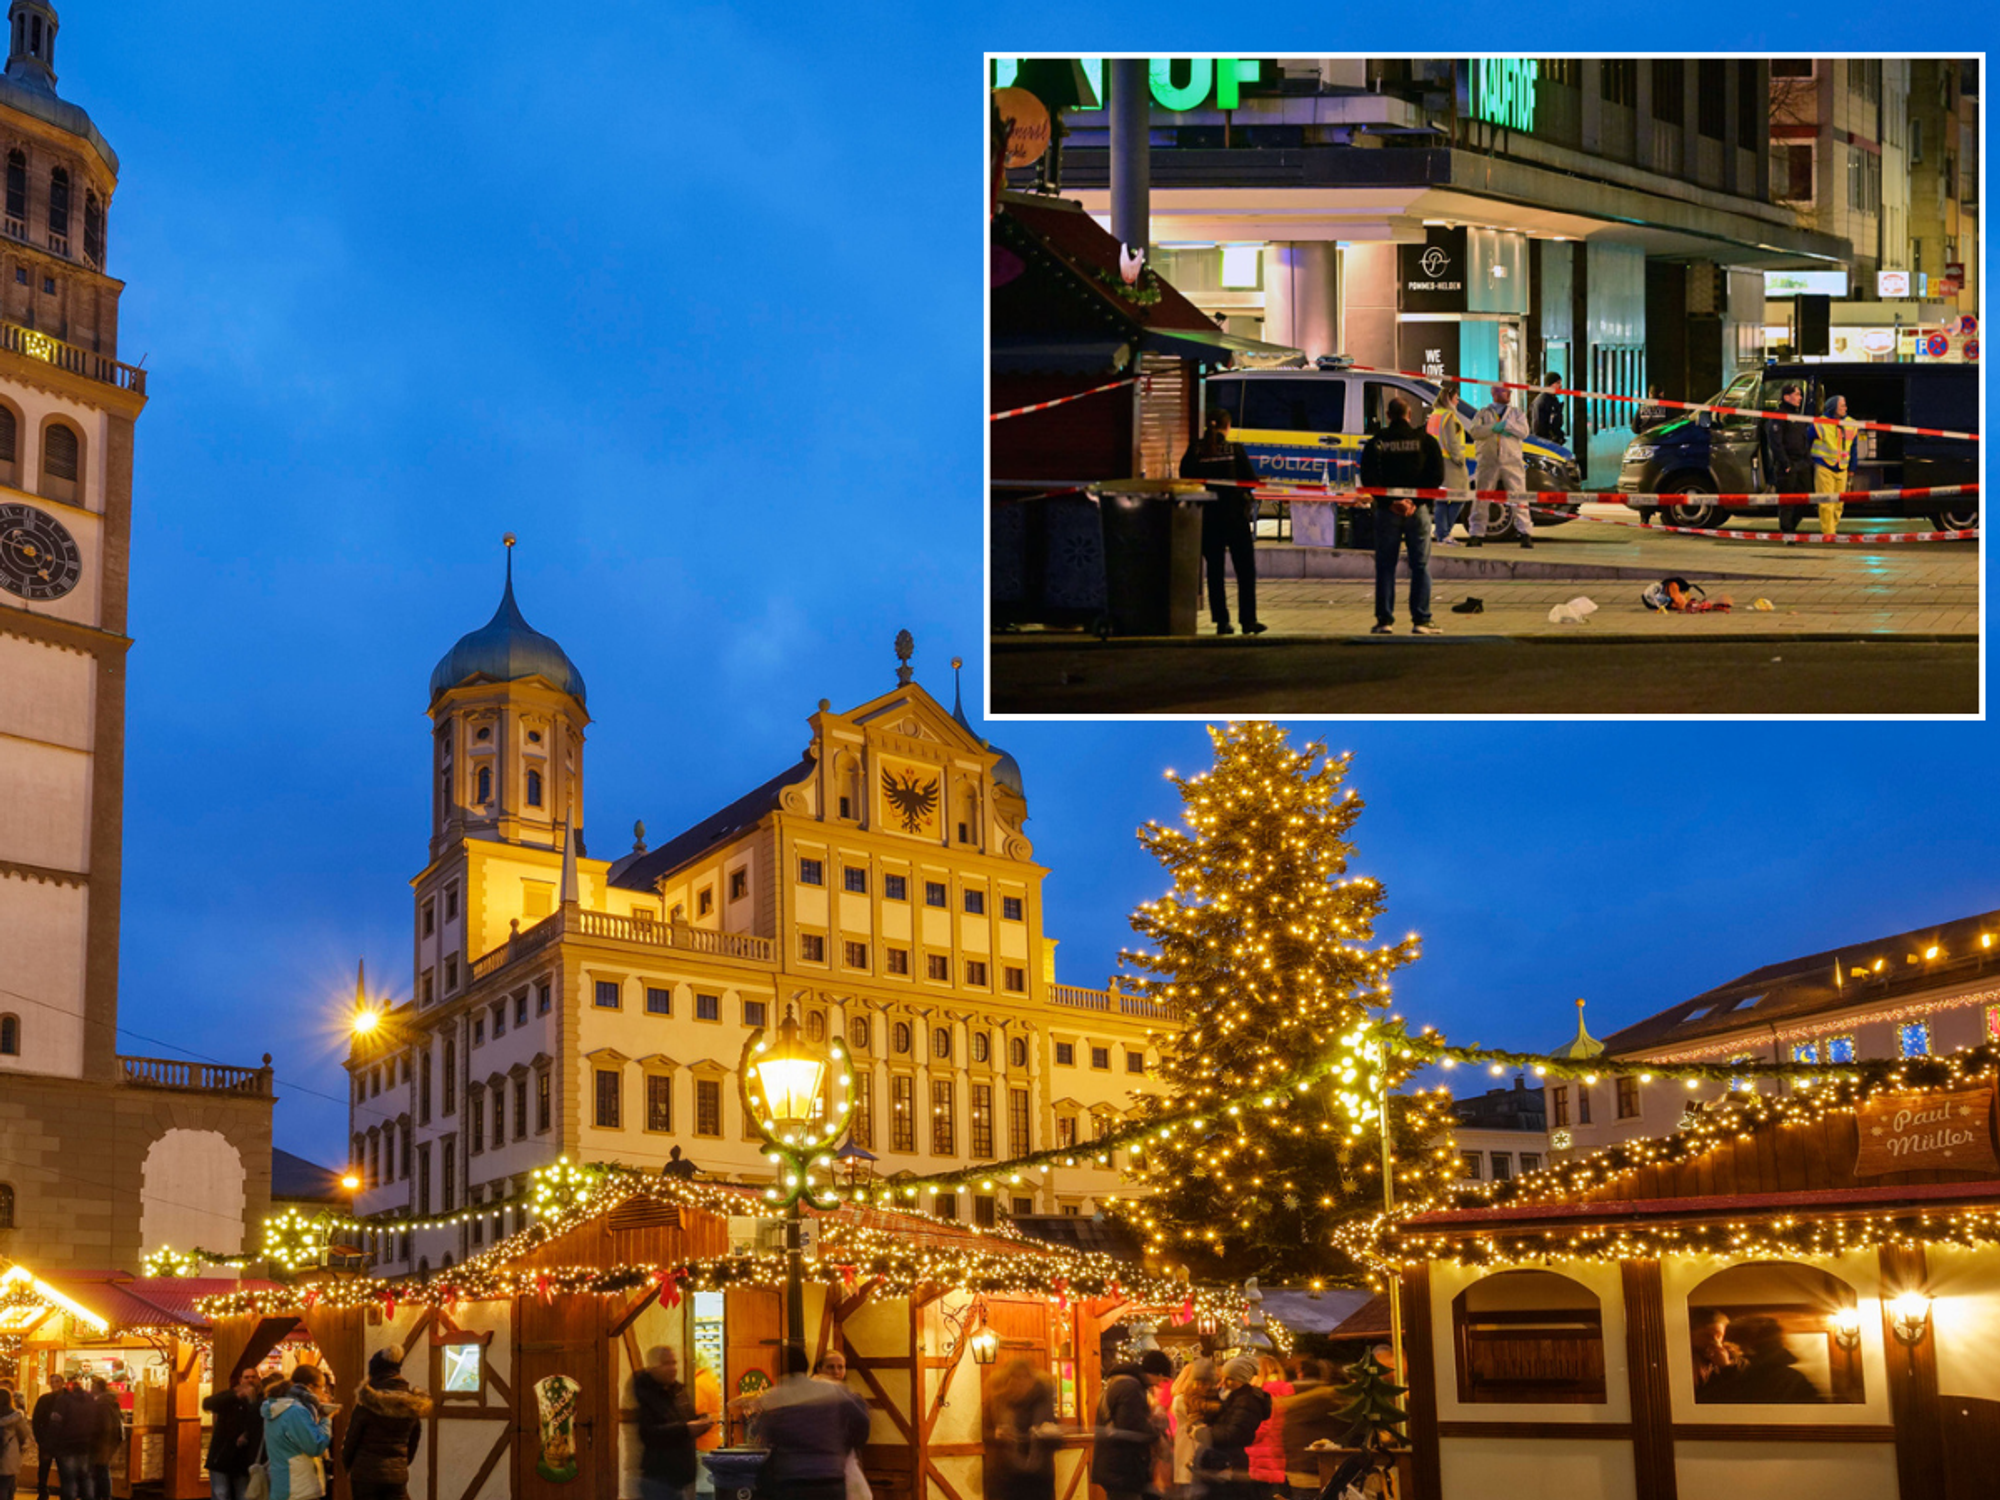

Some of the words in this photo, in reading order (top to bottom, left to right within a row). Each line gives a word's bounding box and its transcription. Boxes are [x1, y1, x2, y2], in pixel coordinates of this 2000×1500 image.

[1425, 348, 1442, 363] WE
[1383, 440, 1421, 452] POLIZEI
[1893, 1101, 1951, 1132] Paul
[1887, 1128, 1975, 1156] Müller
